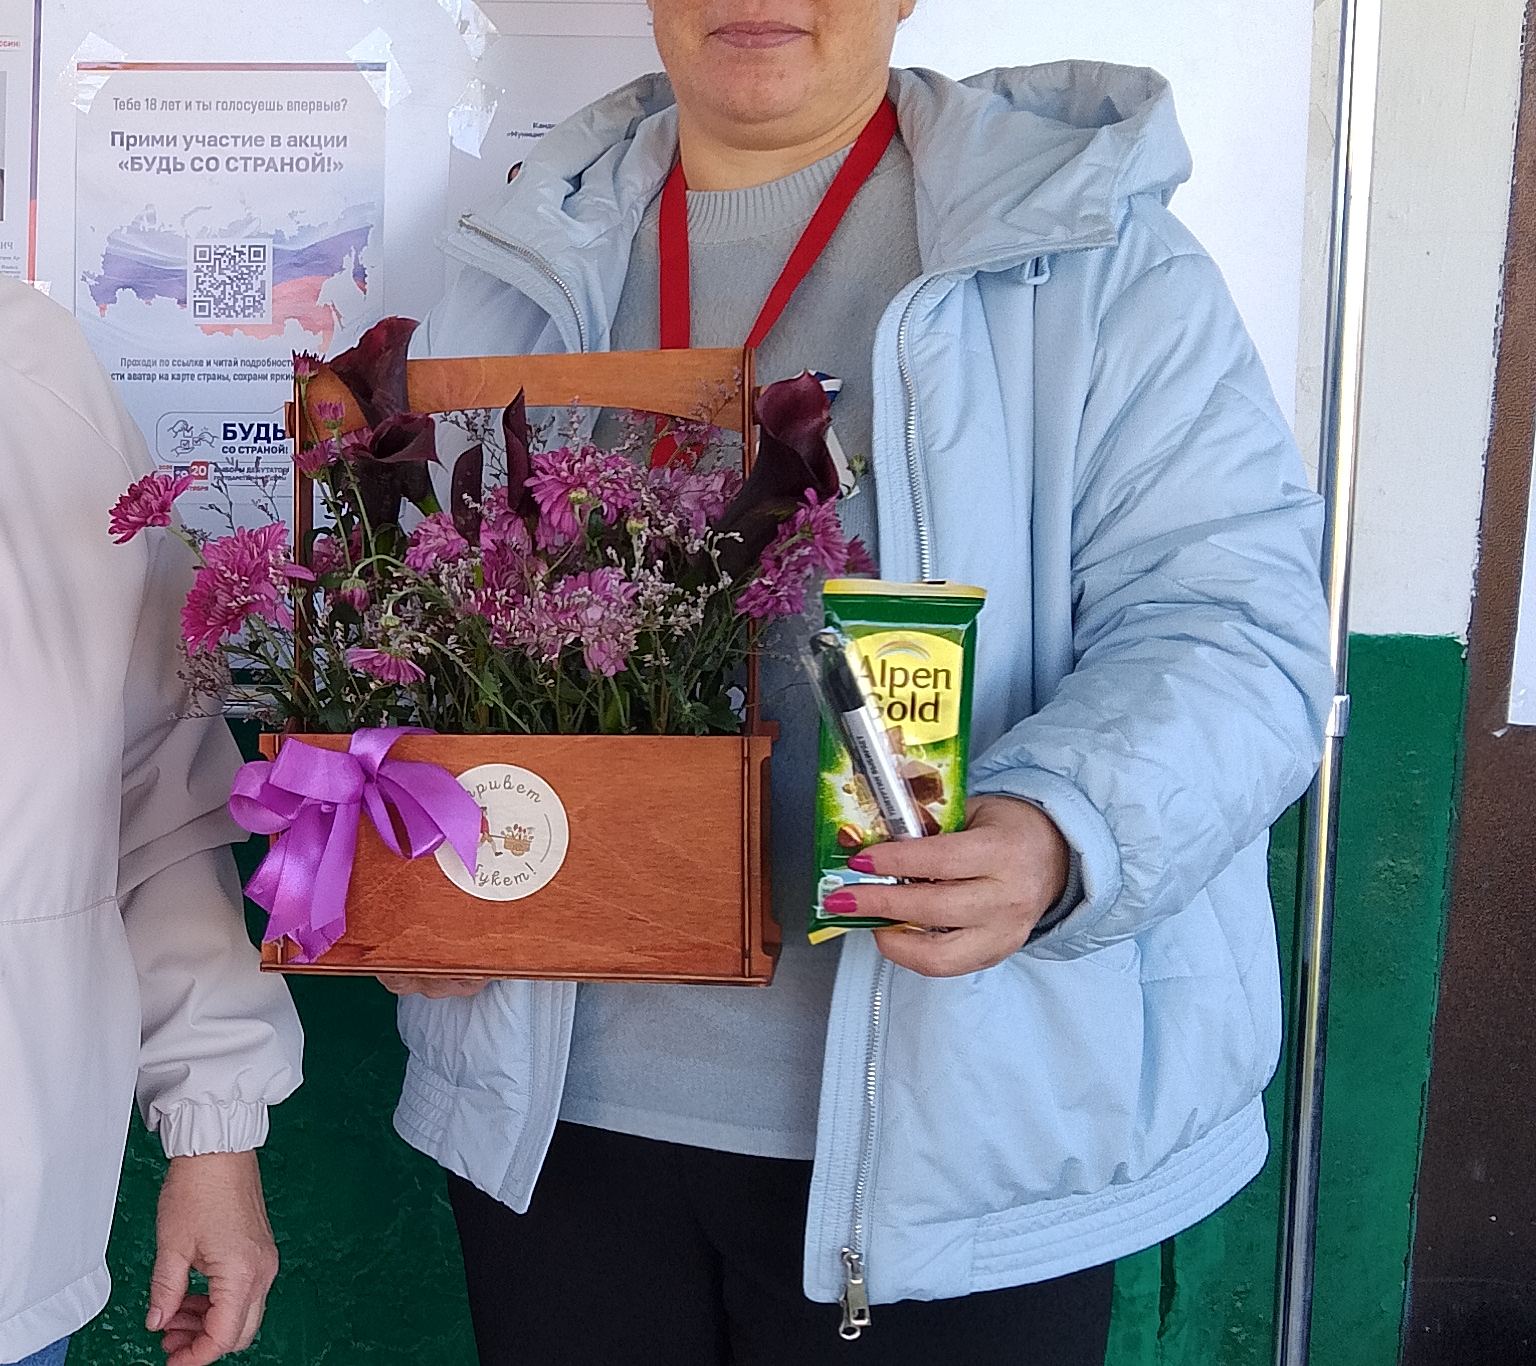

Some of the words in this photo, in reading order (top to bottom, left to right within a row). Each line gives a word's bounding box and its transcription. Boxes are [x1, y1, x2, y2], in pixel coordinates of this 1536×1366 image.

[113, 98, 141, 111] Тебе
[145, 98, 157, 111] 18
[160, 100, 181, 111] лет
[185, 101, 192, 111] и
[196, 100, 211, 111] ты
[216, 101, 283, 114] голосуешь
[287, 98, 347, 114] впервые?
[111, 131, 177, 150] Прими
[182, 135, 264, 151] участие
[271, 135, 282, 147] в
[287, 135, 347, 150] акции
[119, 156, 185, 174] «БУДЬ
[191, 156, 220, 172] СО
[225, 152, 343, 172] СТРАНОЙ!»
[121, 358, 156, 369] Проходи
[172, 358, 204, 367] ссылке
[214, 357, 237, 367] читай
[127, 373, 156, 382] аватар
[172, 373, 195, 382] карте
[198, 373, 231, 382] страны,
[233, 374, 268, 382] сохрани
[223, 423, 286, 444] БУДЬ
[222, 446, 237, 454] СО
[238, 444, 288, 454] СТРАНОЙ!
[191, 465, 207, 475] 20
[859, 655, 952, 698] Alpen
[866, 691, 940, 723] Gold
